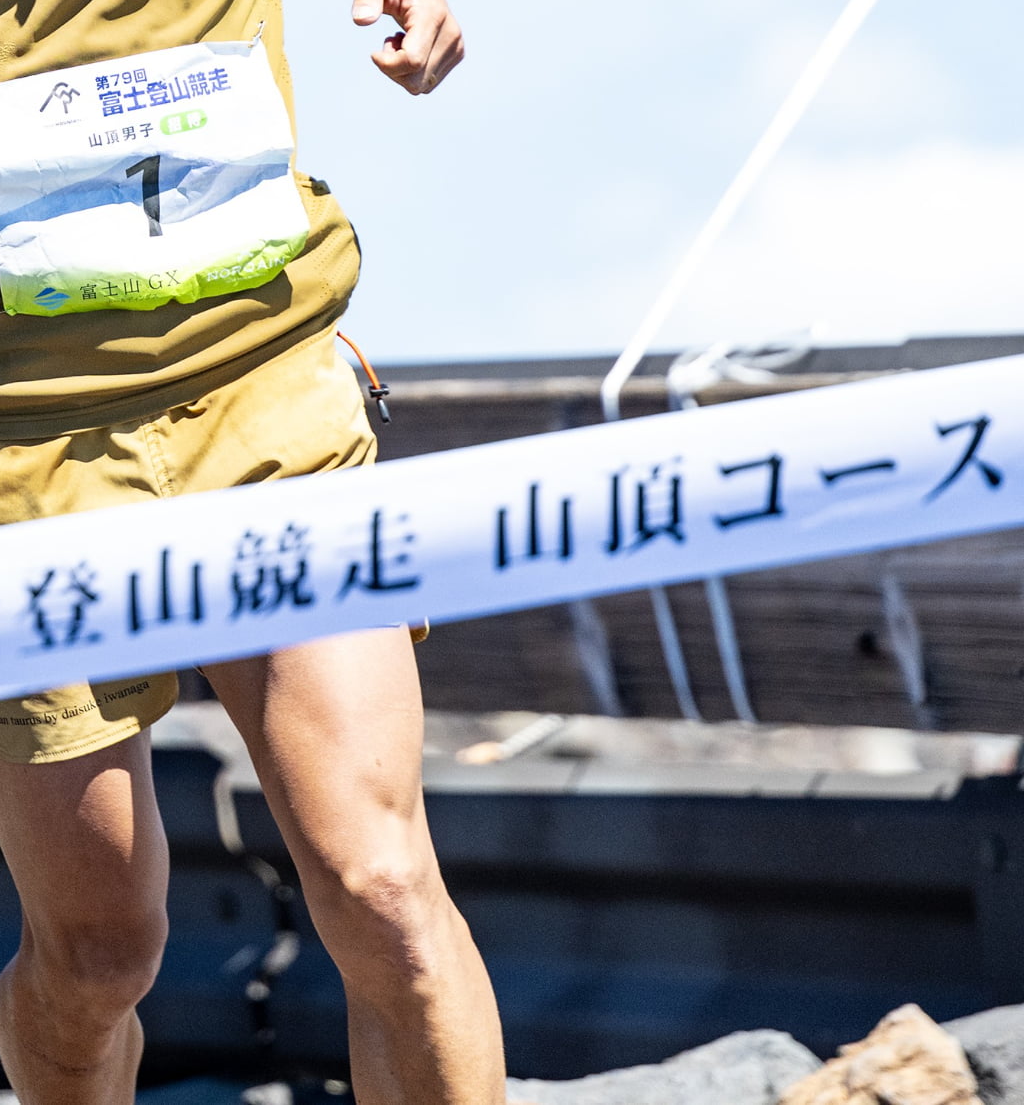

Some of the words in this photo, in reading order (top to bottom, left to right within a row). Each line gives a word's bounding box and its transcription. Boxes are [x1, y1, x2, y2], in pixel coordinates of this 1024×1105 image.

[95, 68, 147, 90] 第79回
[99, 68, 231, 117] 富士登山競走
[88, 123, 154, 148] 山頂男子
[126, 155, 164, 237] 1
[80, 278, 140, 300] 富士山
[148, 270, 182, 290] GX
[494, 415, 1005, 571] 山頂コース
[11, 713, 42, 726] taurus
[44, 712, 58, 726] by
[62, 698, 102, 720] daisuke
[103, 680, 150, 703] iwanaga
